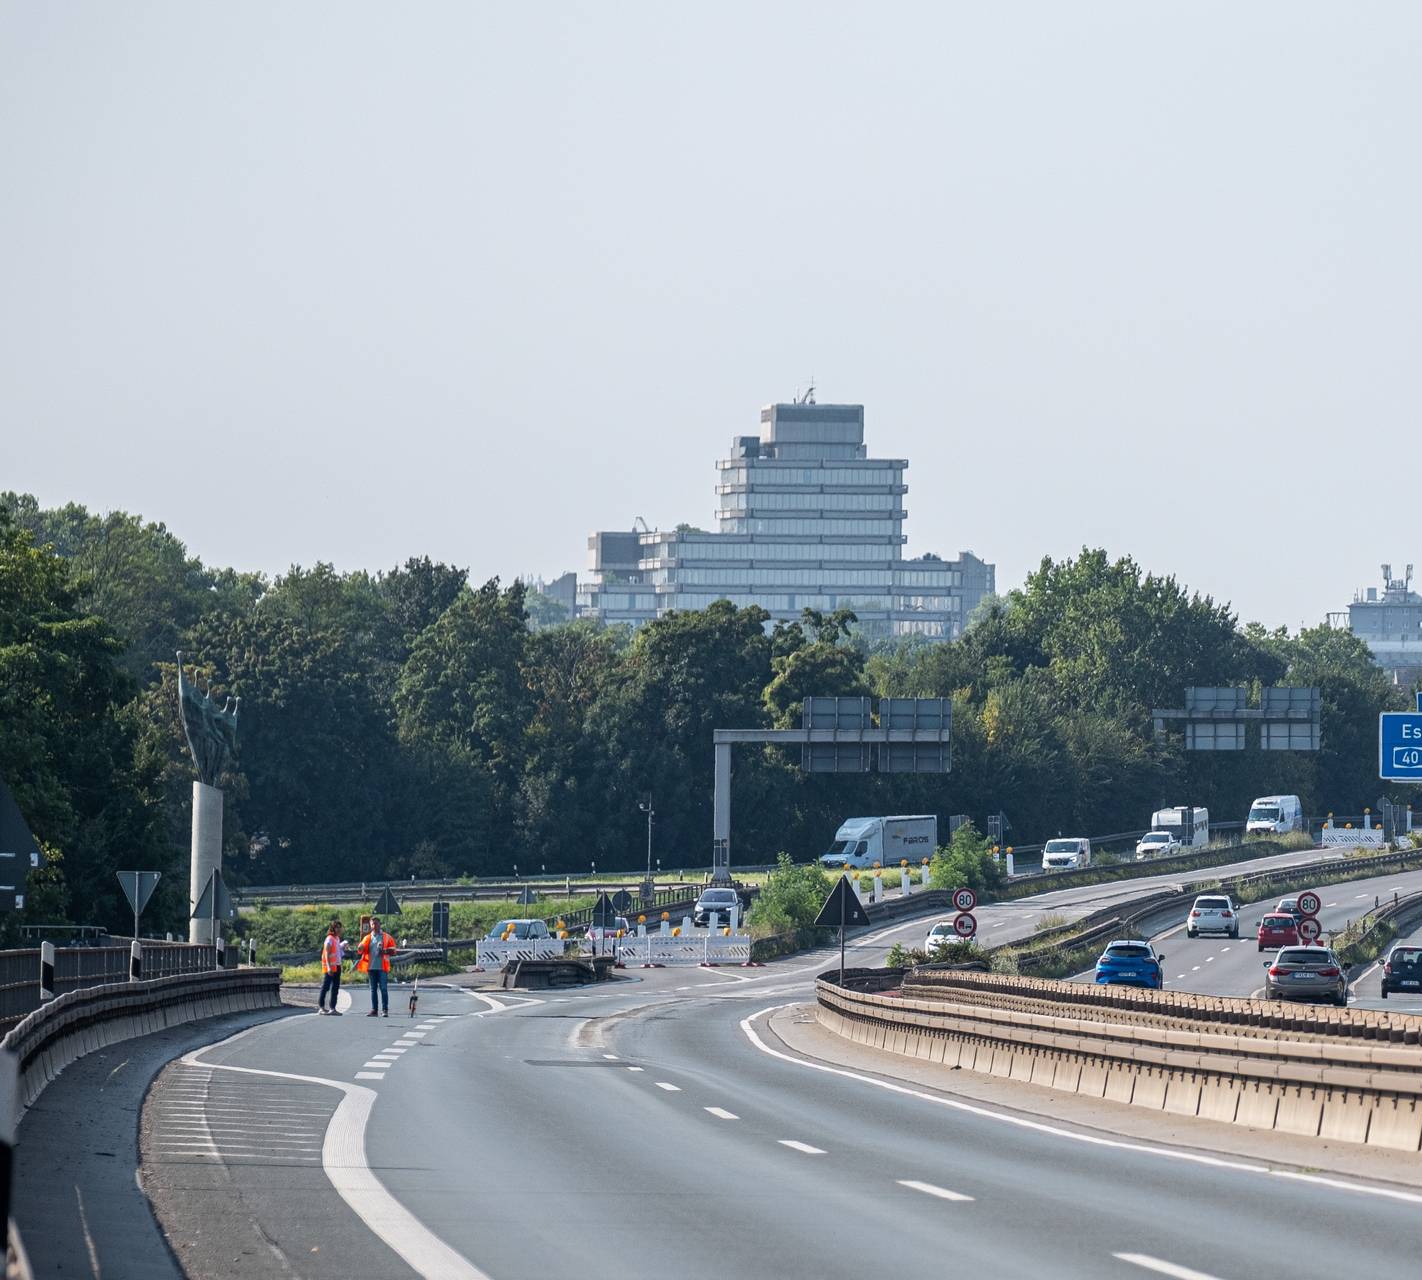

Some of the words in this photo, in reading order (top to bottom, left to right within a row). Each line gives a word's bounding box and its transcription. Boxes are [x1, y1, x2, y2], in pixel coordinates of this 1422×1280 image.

[1402, 751, 1419, 764] 40
[959, 894, 976, 906] 80
[1302, 899, 1316, 910] 80
